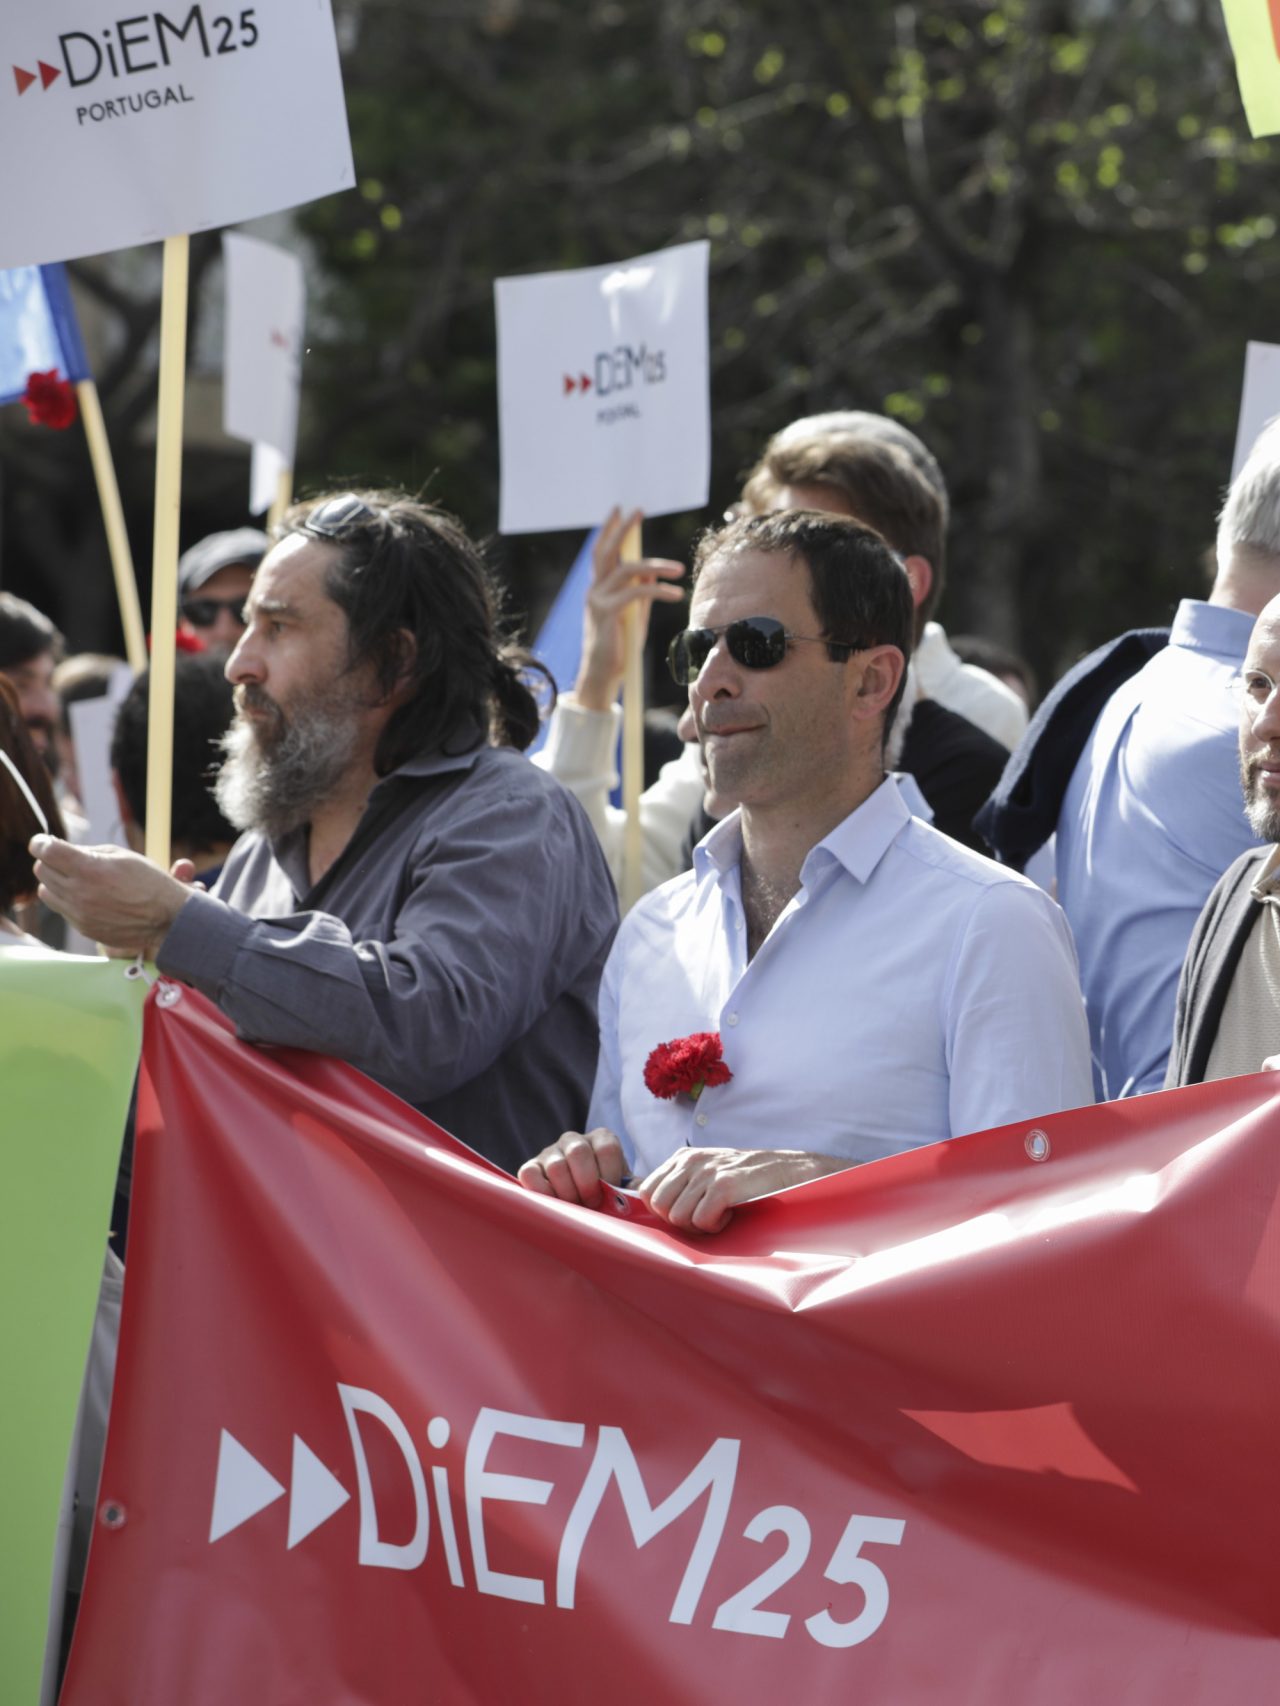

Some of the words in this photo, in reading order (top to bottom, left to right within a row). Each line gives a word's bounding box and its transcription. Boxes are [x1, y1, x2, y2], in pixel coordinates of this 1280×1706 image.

[58, 3, 260, 88] DiEM25
[76, 84, 195, 126] PORTUGAL
[337, 1383, 906, 1648] DiEM25
